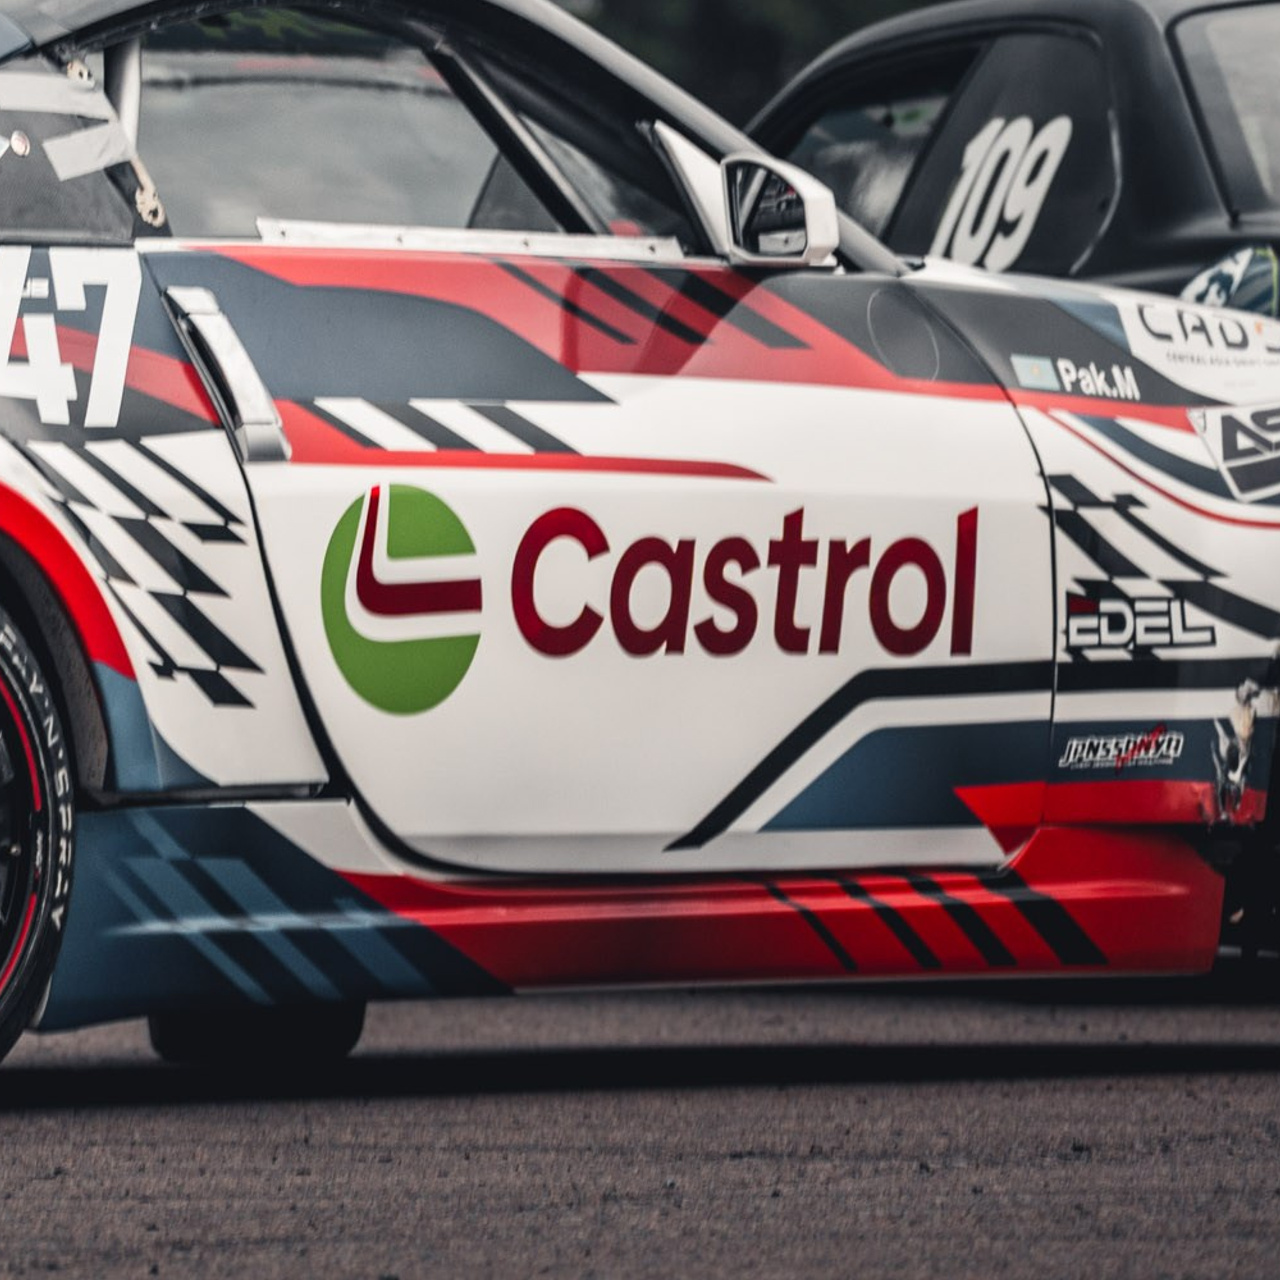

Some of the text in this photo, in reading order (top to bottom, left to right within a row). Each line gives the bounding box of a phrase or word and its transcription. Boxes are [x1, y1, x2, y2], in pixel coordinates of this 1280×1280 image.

[926, 115, 1073, 272] 109
[1056, 357, 1141, 402] Pak.M
[511, 504, 979, 658] Castrol
[1066, 591, 1217, 649] EDEL
